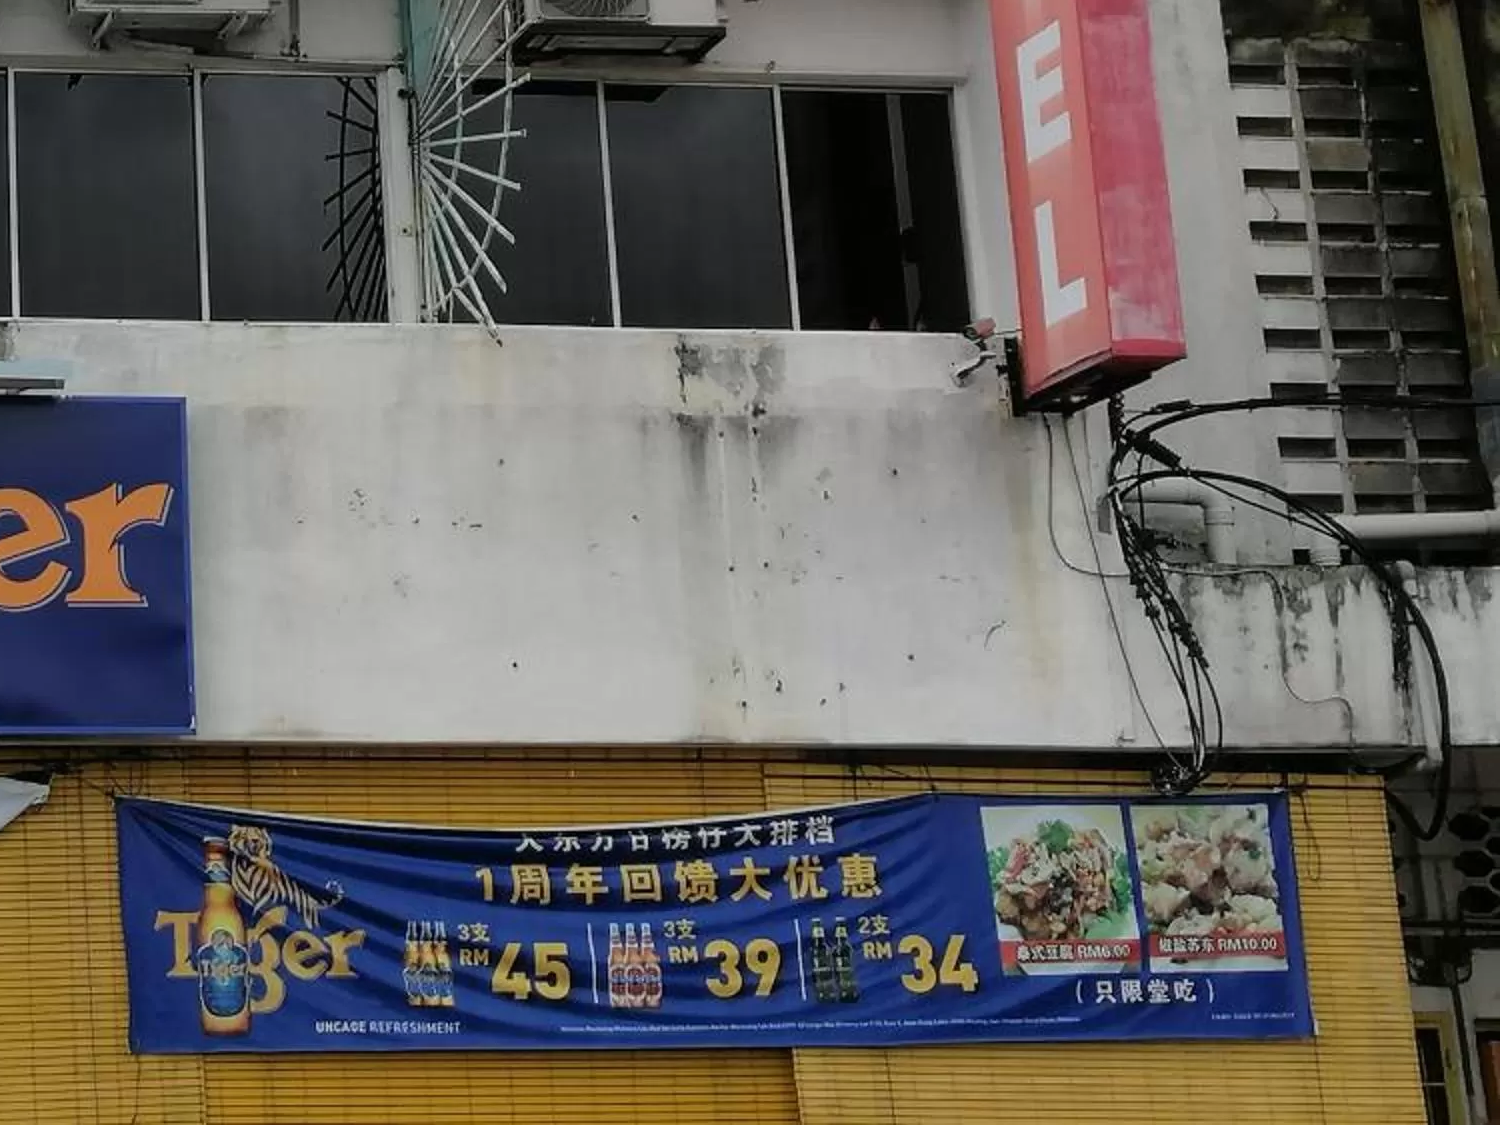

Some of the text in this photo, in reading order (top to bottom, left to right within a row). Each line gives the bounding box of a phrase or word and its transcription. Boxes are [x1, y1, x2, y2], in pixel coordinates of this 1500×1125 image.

[474, 852, 884, 906] 1周年回馈大优惠
[459, 948, 490, 966] RM
[491, 942, 572, 1000] 45
[668, 946, 699, 964] RM
[705, 938, 782, 998] 39
[863, 934, 979, 994] RM 34
[315, 1020, 461, 1035] UNCAGE REFRESHMENT
